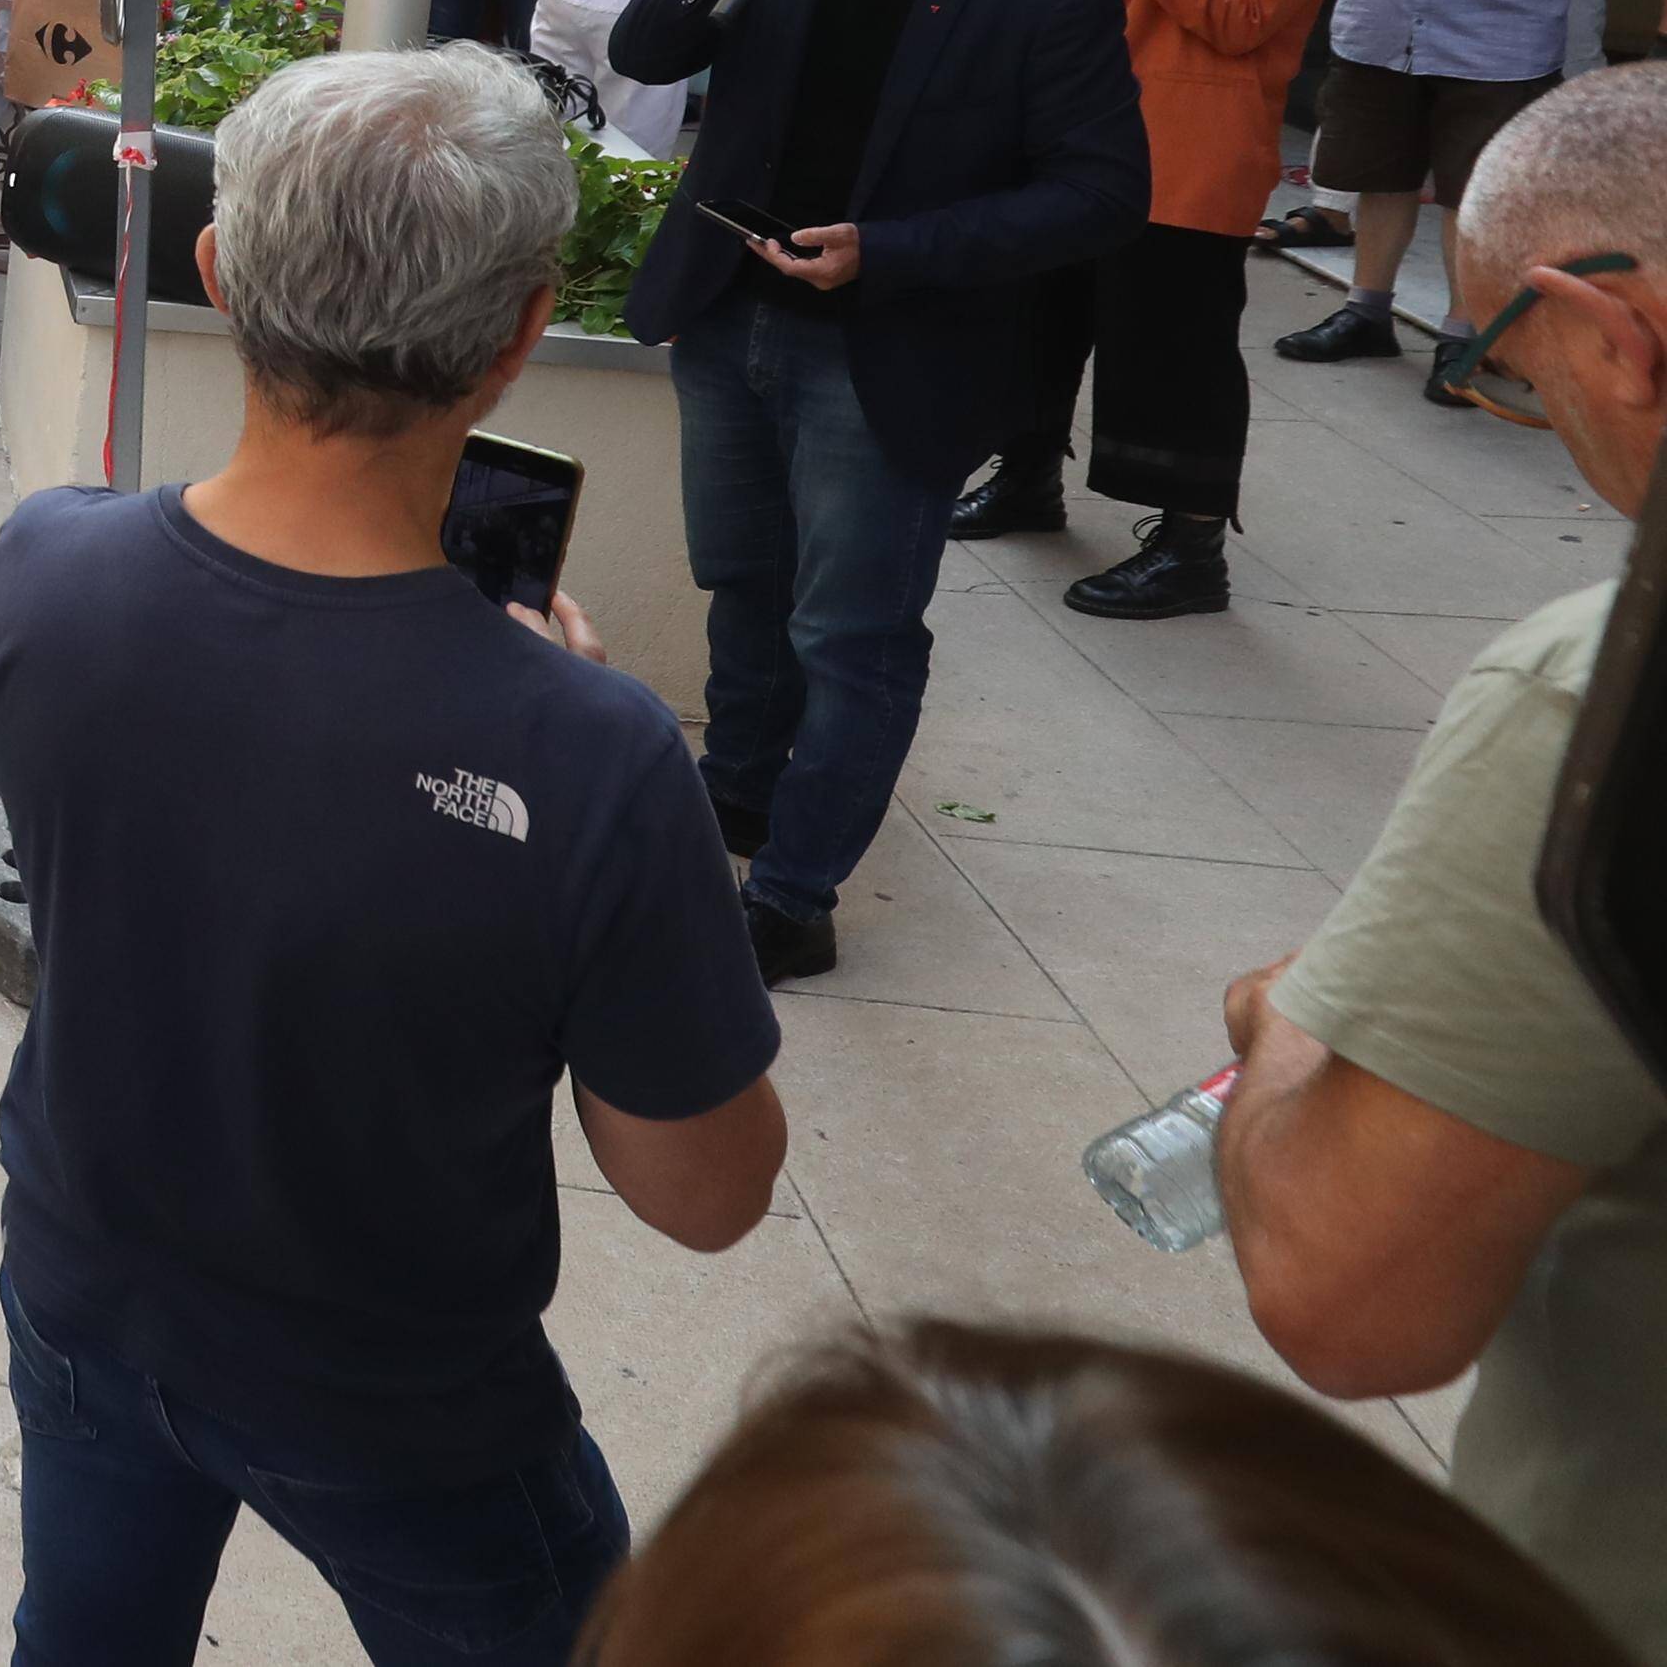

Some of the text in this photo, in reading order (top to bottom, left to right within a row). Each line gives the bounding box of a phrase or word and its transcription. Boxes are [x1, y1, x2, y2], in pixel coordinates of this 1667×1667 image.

[416, 772, 493, 813] NORTH
[454, 767, 497, 796] THE
[433, 796, 489, 829] FACE
